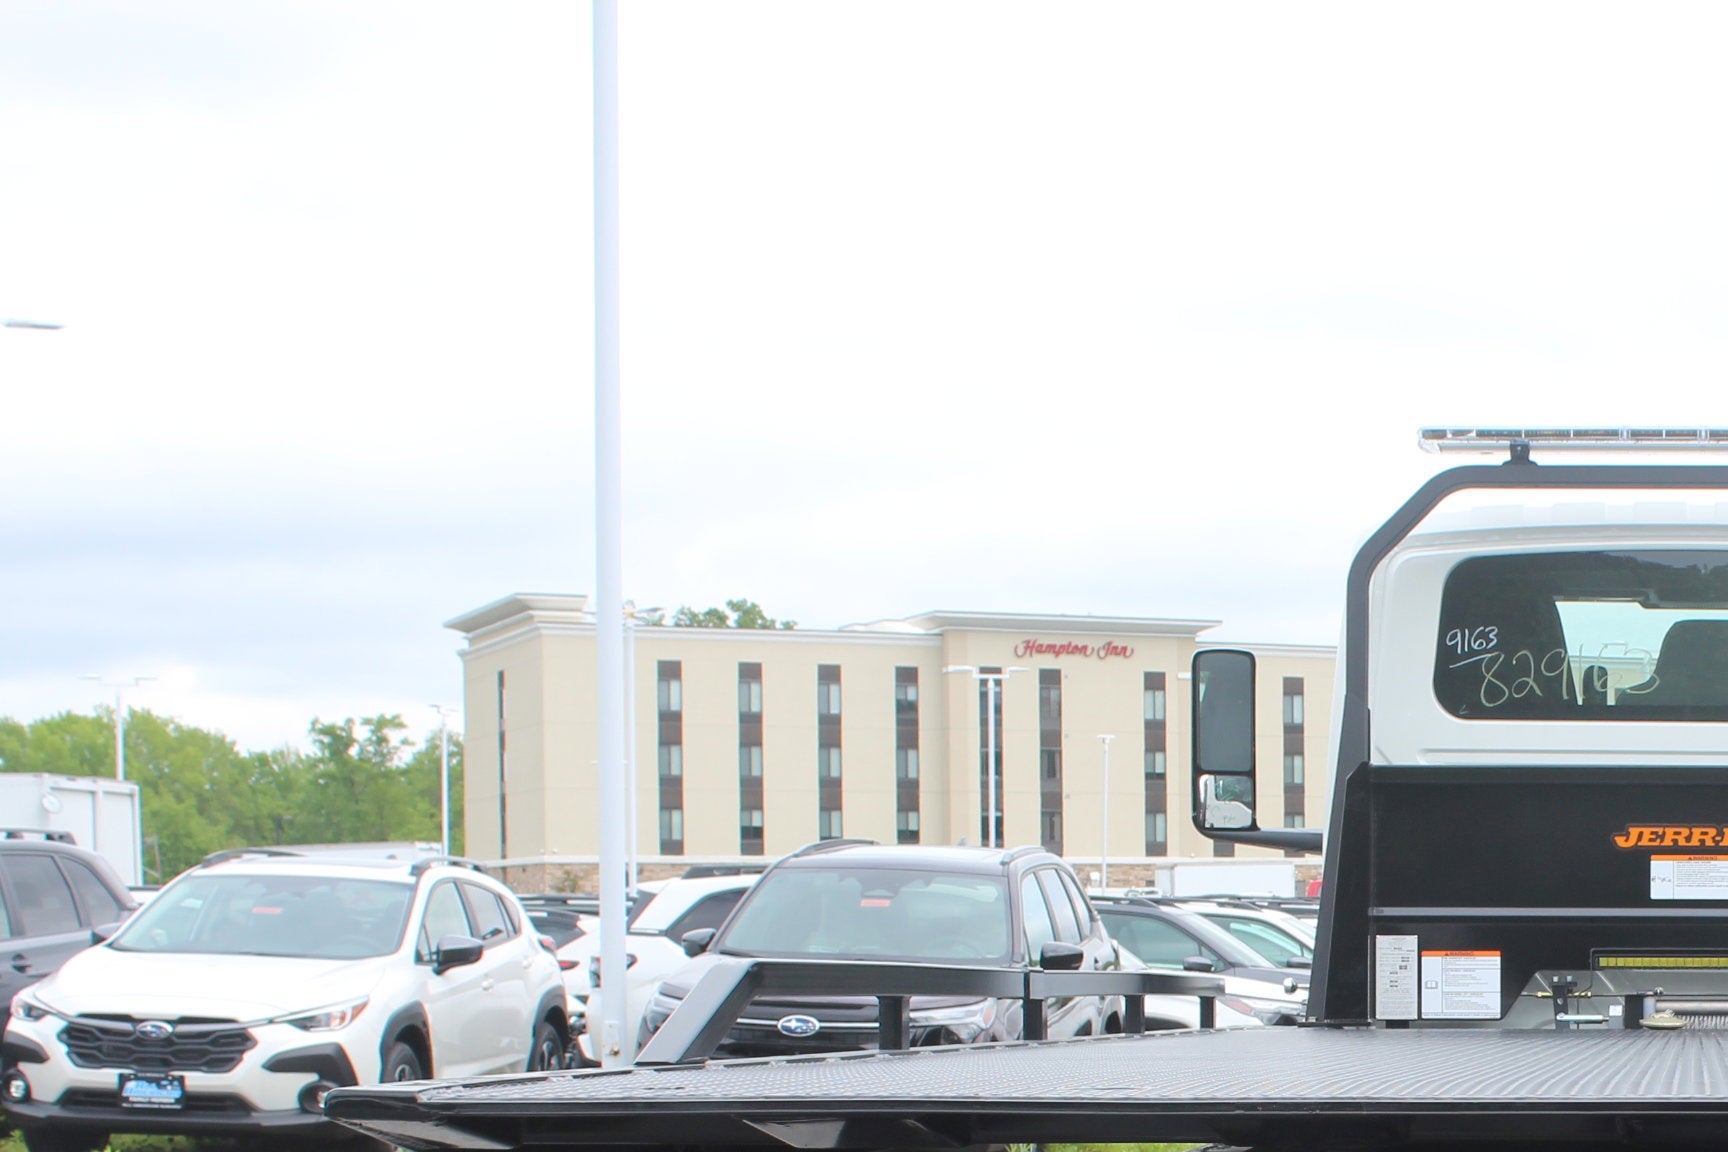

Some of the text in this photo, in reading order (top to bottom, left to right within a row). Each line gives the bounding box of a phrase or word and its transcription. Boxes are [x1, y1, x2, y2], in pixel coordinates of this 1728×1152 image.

[1014, 638, 1135, 659] Hampton Inn
[1445, 625, 1499, 655] 9163
